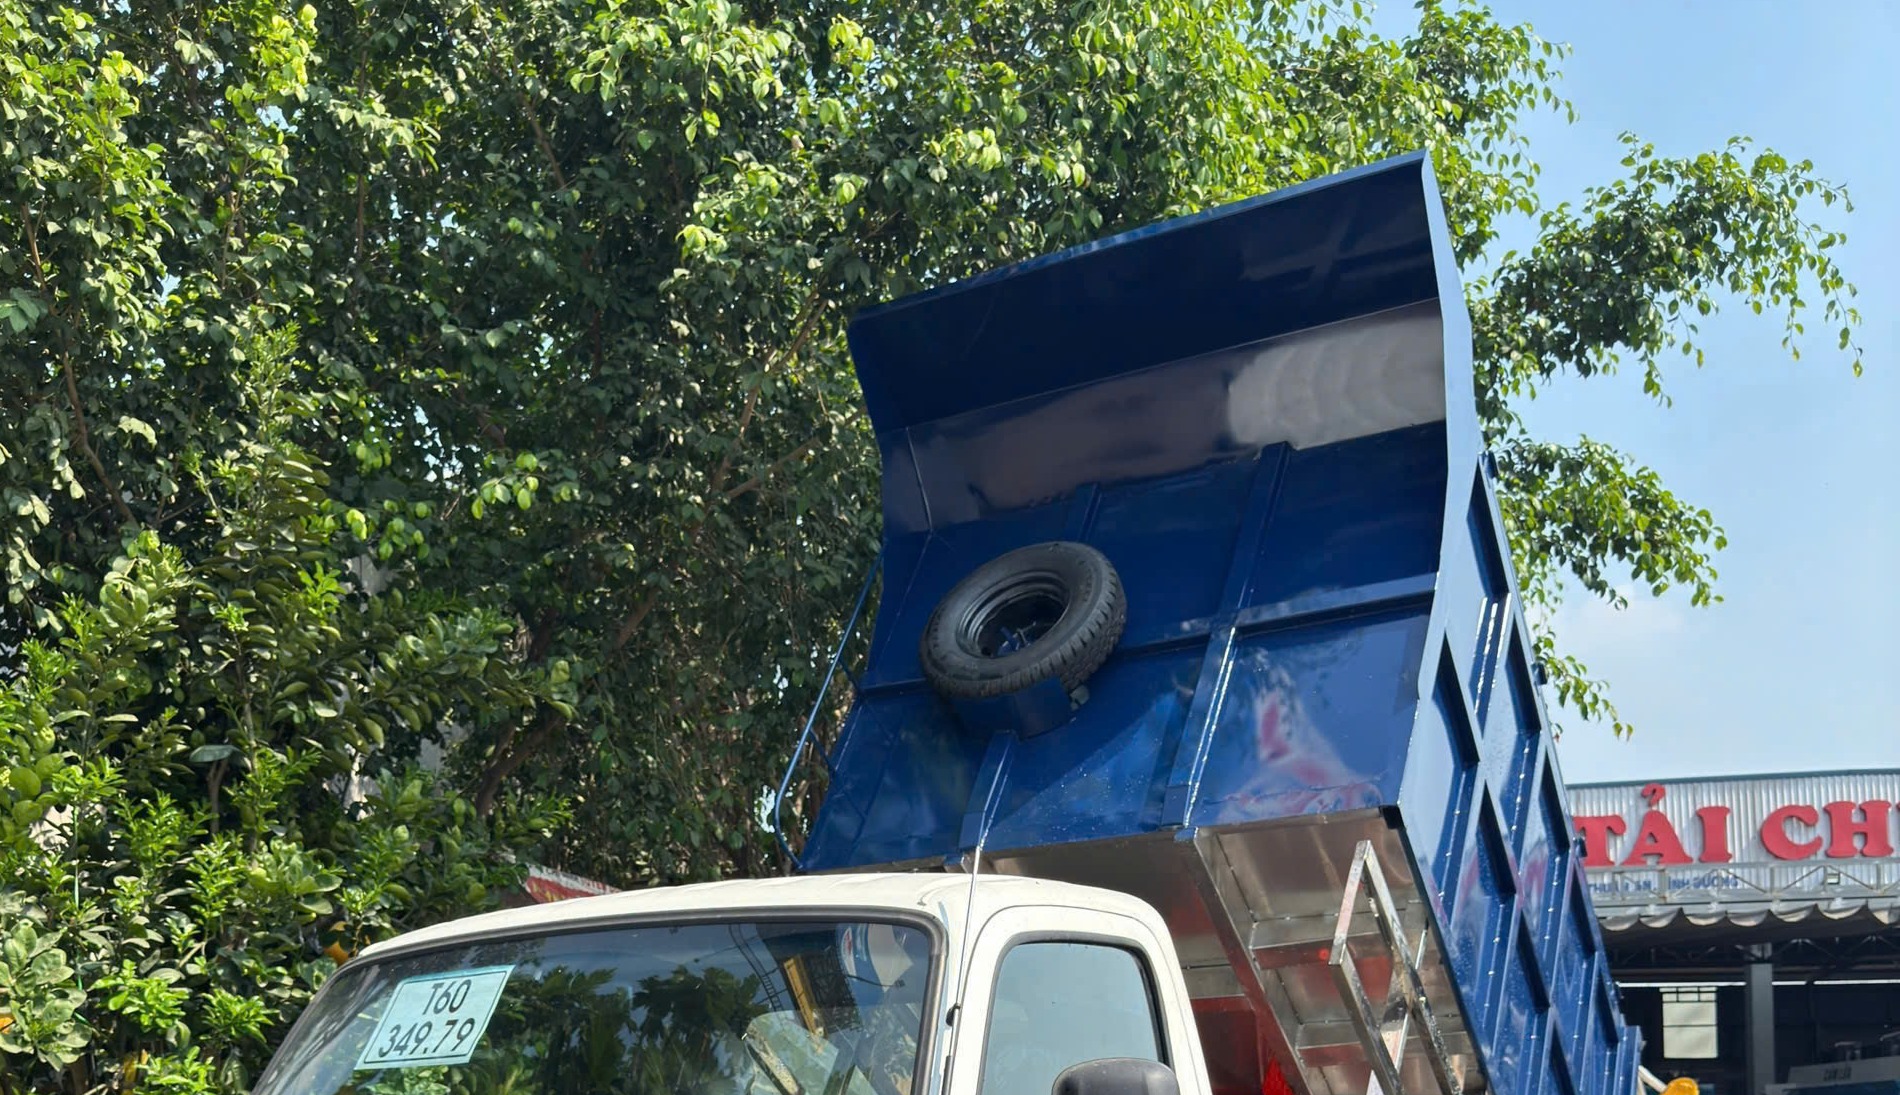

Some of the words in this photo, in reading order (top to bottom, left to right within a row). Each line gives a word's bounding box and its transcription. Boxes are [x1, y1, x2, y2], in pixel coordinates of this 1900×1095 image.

[1573, 783, 1733, 867] TẢI
[1760, 799, 1900, 861] CH
[422, 979, 472, 1015] T60
[378, 1017, 475, 1058] 349.79
